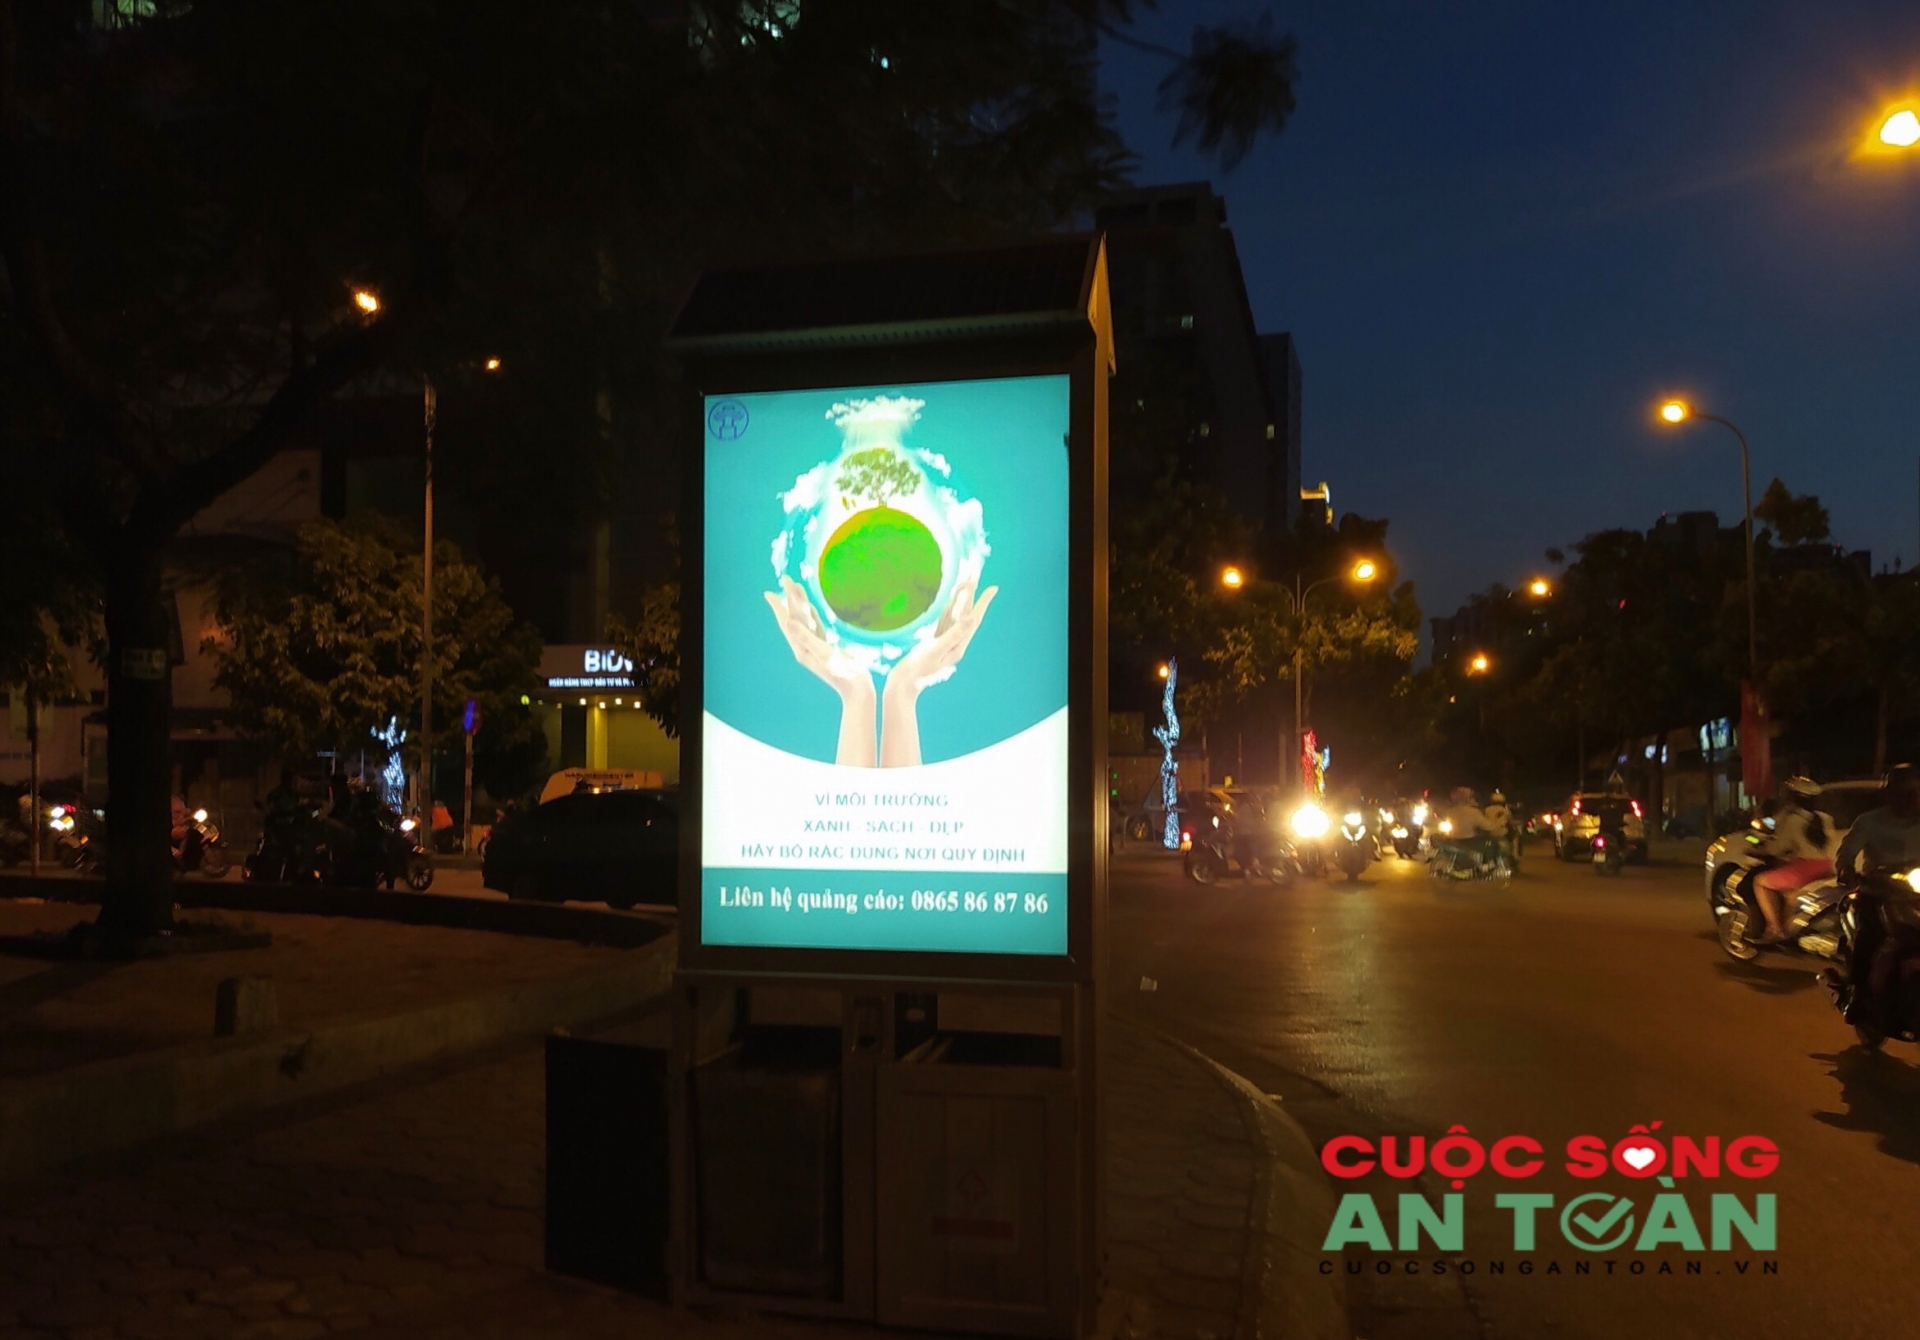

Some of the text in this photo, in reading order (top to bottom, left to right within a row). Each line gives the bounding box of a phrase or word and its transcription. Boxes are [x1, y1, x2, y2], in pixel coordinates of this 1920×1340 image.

[835, 791, 866, 806] MÔI
[803, 819, 850, 833] XANH
[942, 848, 977, 862] QUY
[720, 886, 1048, 913] Liên hệ quảng cáo: 0865 86 87 86
